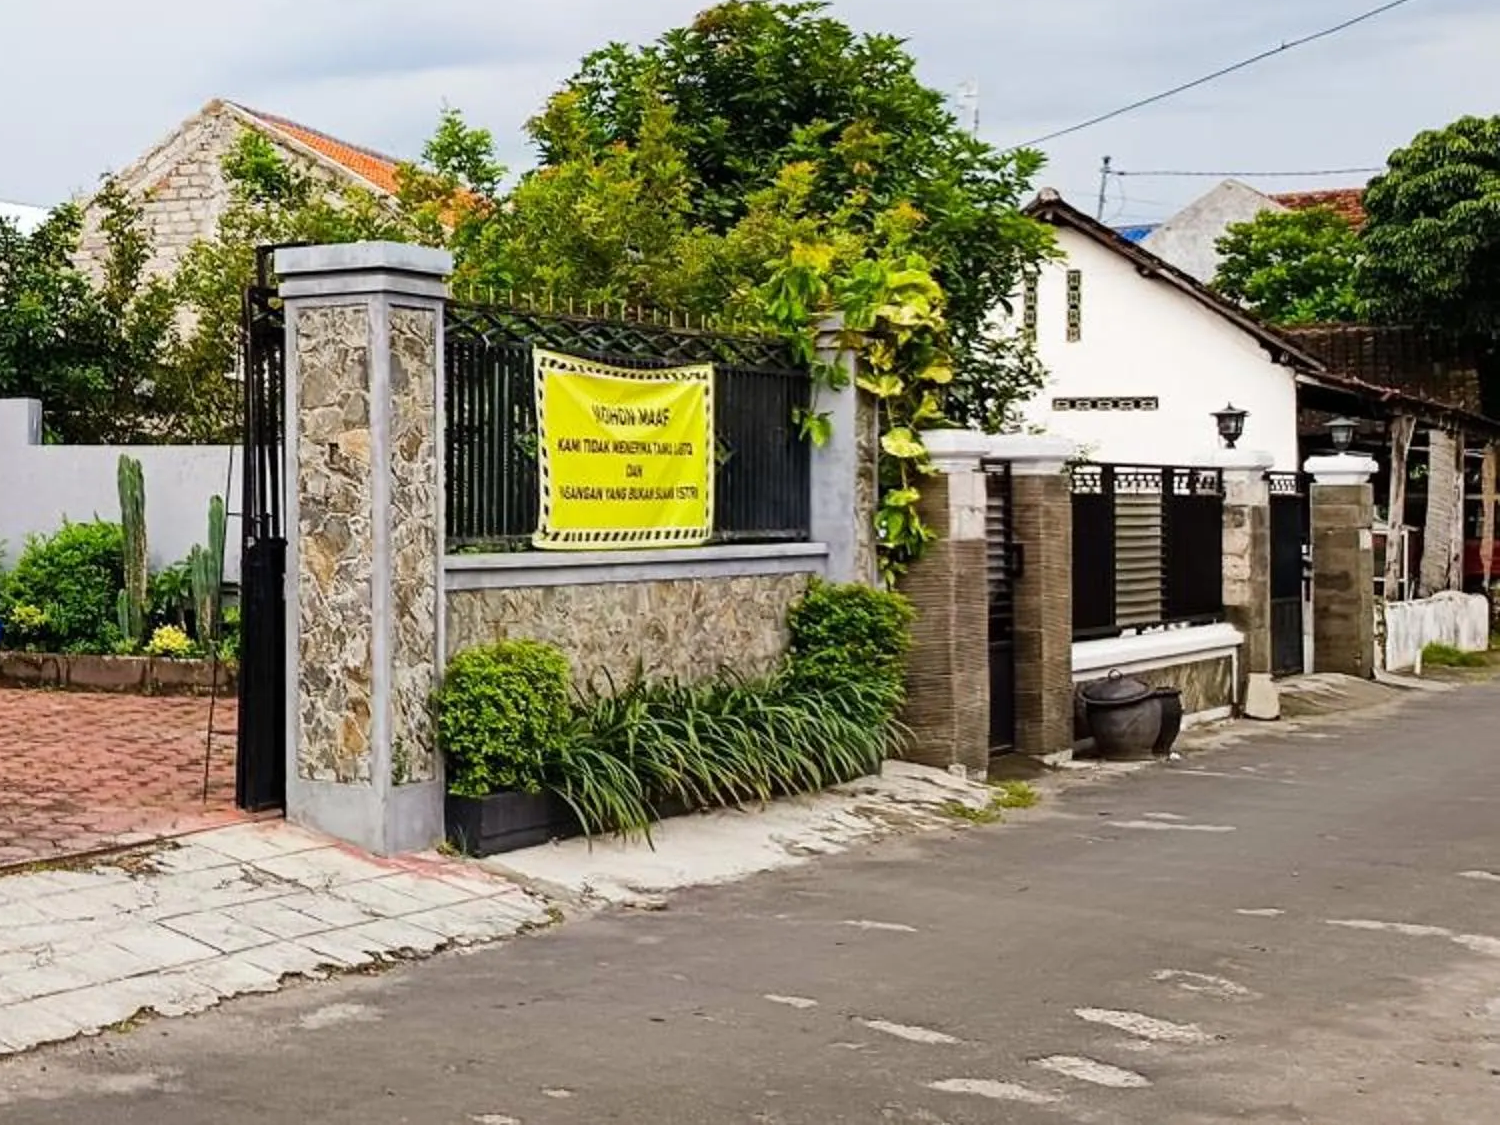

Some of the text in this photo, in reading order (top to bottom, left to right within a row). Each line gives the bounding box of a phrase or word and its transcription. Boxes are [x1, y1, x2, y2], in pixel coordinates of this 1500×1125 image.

[558, 438, 581, 452] KAMI
[583, 438, 611, 453] TIDAK
[626, 463, 643, 478] DAN
[605, 486, 627, 500] YANG
